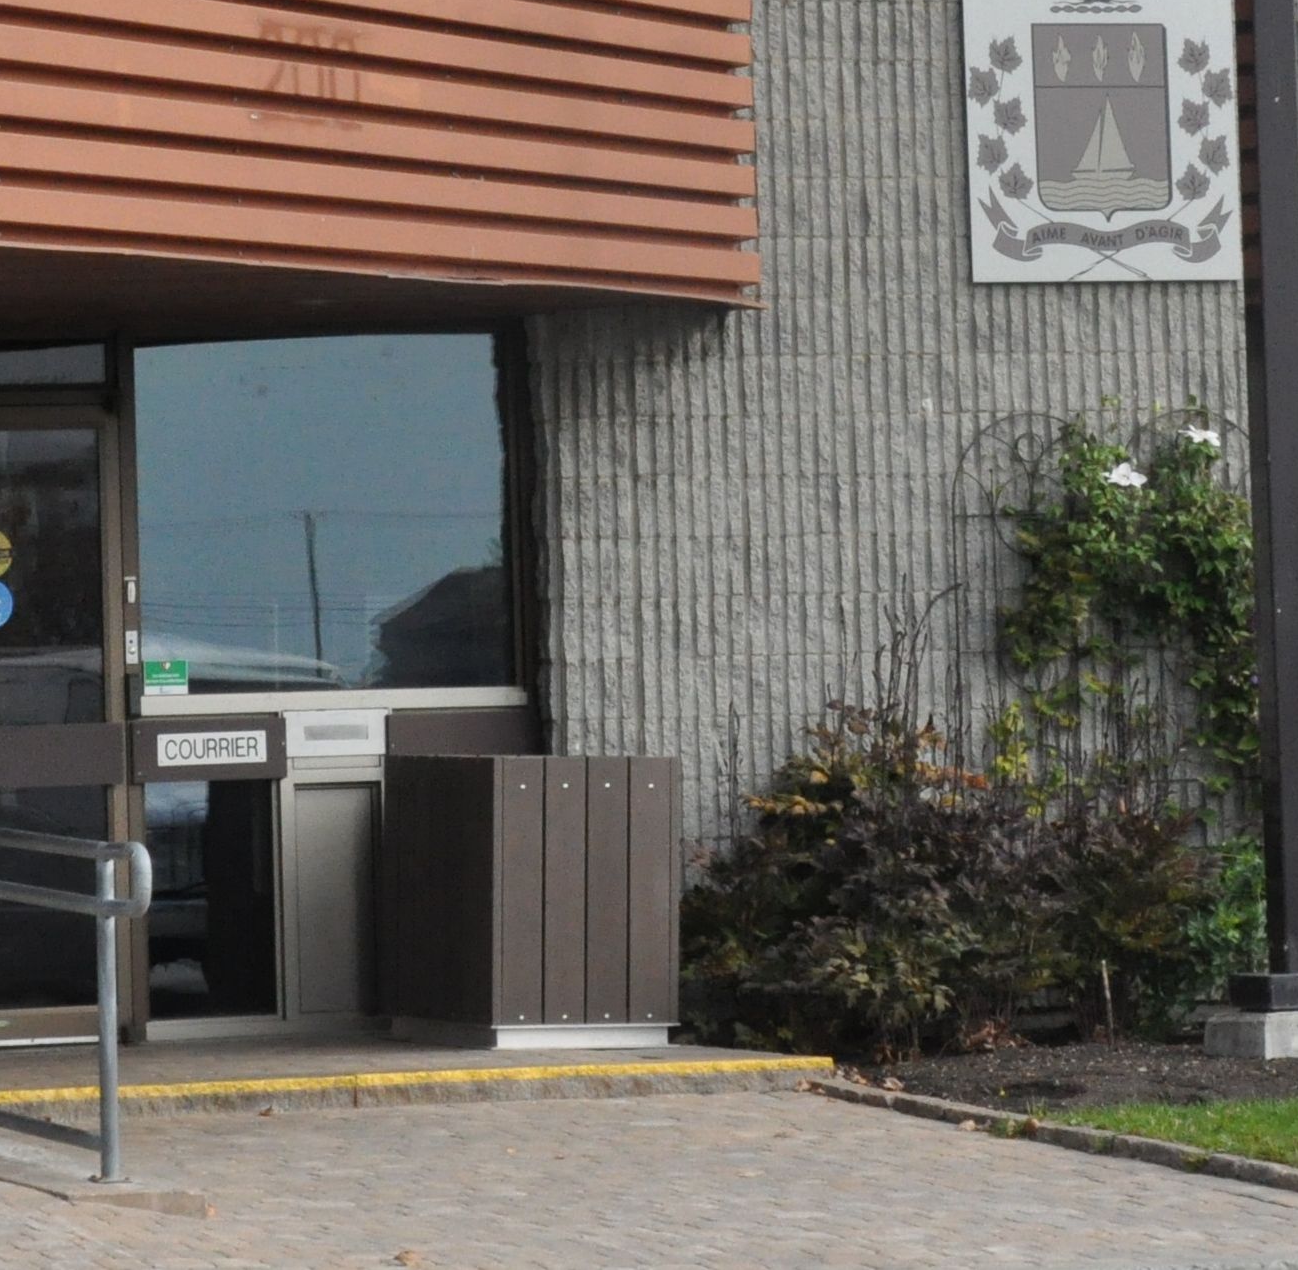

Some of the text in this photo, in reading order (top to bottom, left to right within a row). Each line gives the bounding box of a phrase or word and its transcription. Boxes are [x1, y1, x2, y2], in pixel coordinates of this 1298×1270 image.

[1032, 225, 1183, 247] AIME AVANT D'AGIR
[165, 736, 259, 760] COURRIER
